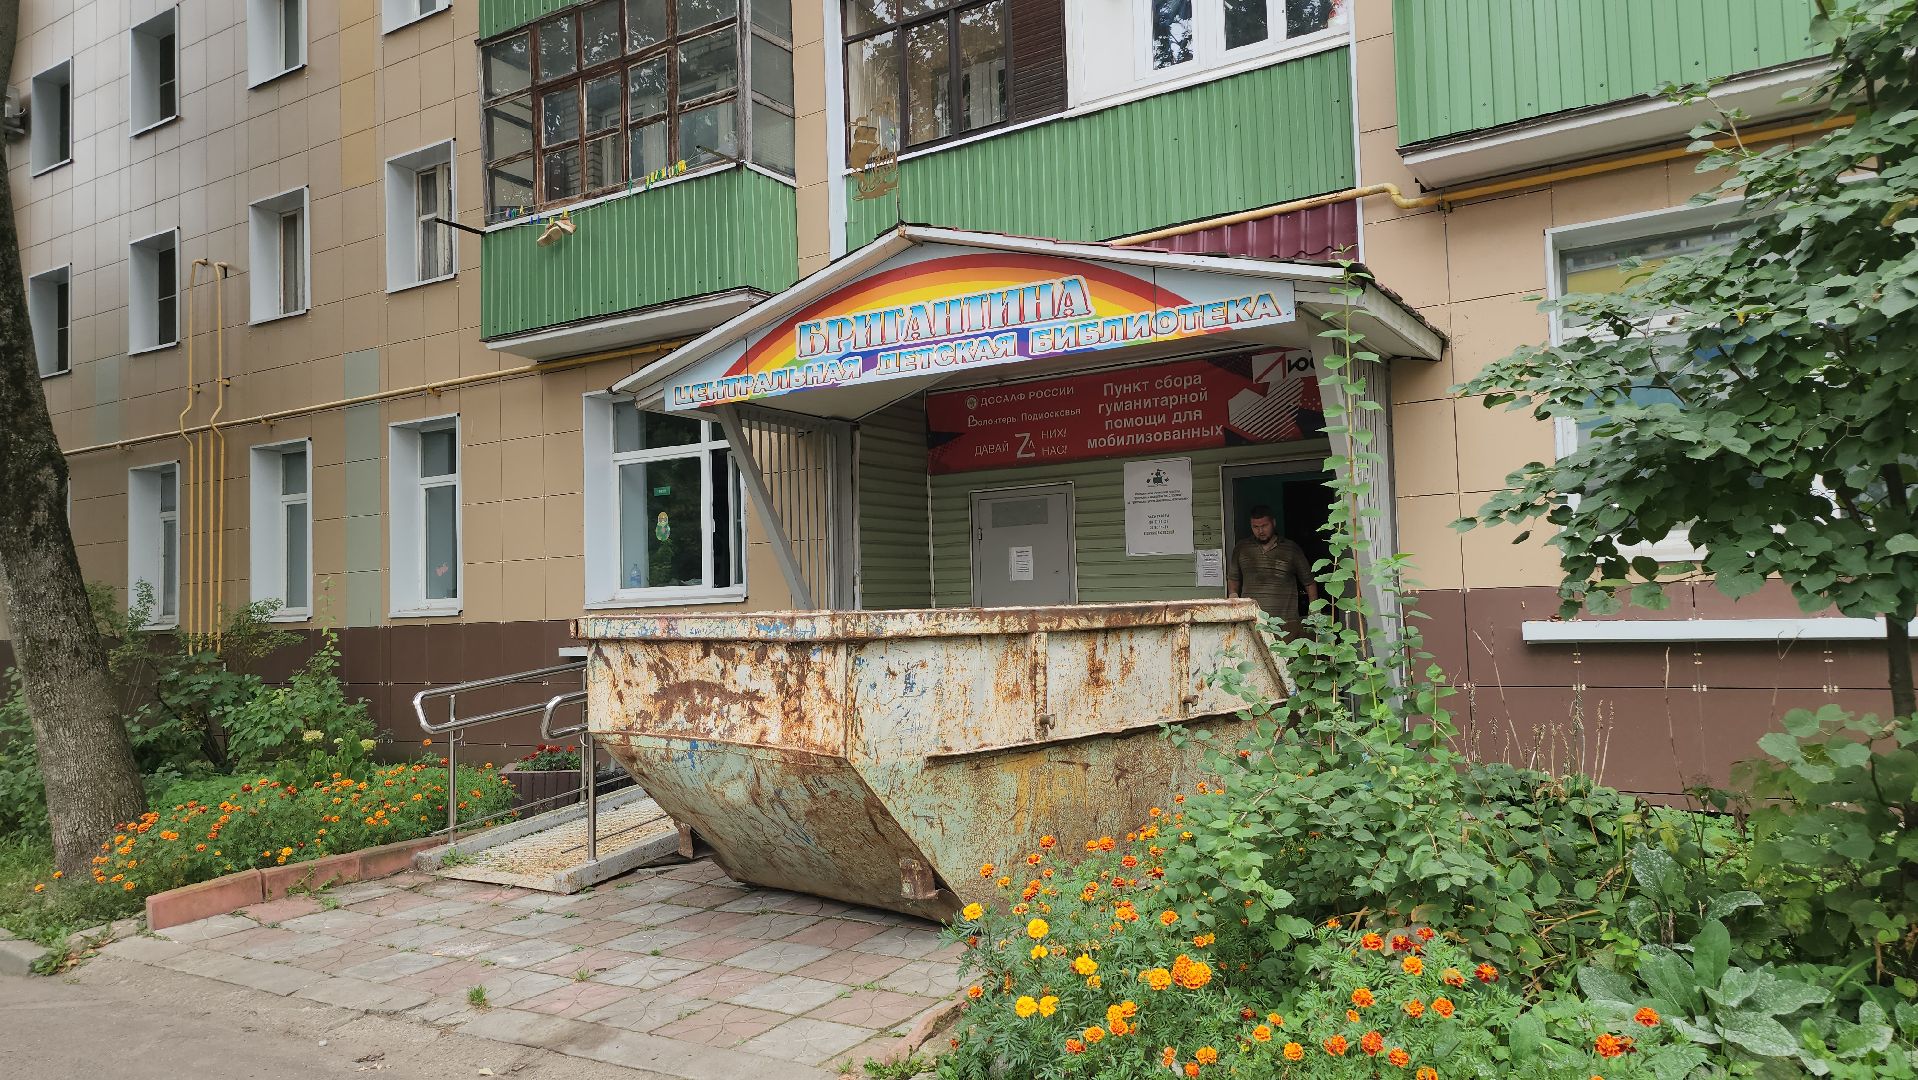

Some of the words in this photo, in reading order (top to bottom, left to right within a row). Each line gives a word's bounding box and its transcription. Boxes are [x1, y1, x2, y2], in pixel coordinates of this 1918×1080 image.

[796, 277, 1093, 358] БРИГАНТИНА
[674, 357, 861, 405] ЦЕНТРАЛЬНАЯ
[876, 334, 1016, 375] ДЕТСКАЯ
[1030, 293, 1282, 354] БИБЛИОТЕКА
[1029, 387, 1074, 400] РОССИИ
[1103, 380, 1149, 398] Пункт
[1155, 374, 1202, 389] сбора
[1098, 387, 1208, 416] гуманитарной
[1105, 413, 1166, 430] помощи
[1171, 409, 1203, 425] для
[1041, 427, 1067, 440] НИХ!
[1087, 424, 1223, 449] мобилизованных
[975, 440, 1009, 457] ДАВАЙ
[1041, 444, 1068, 457] НАС!
